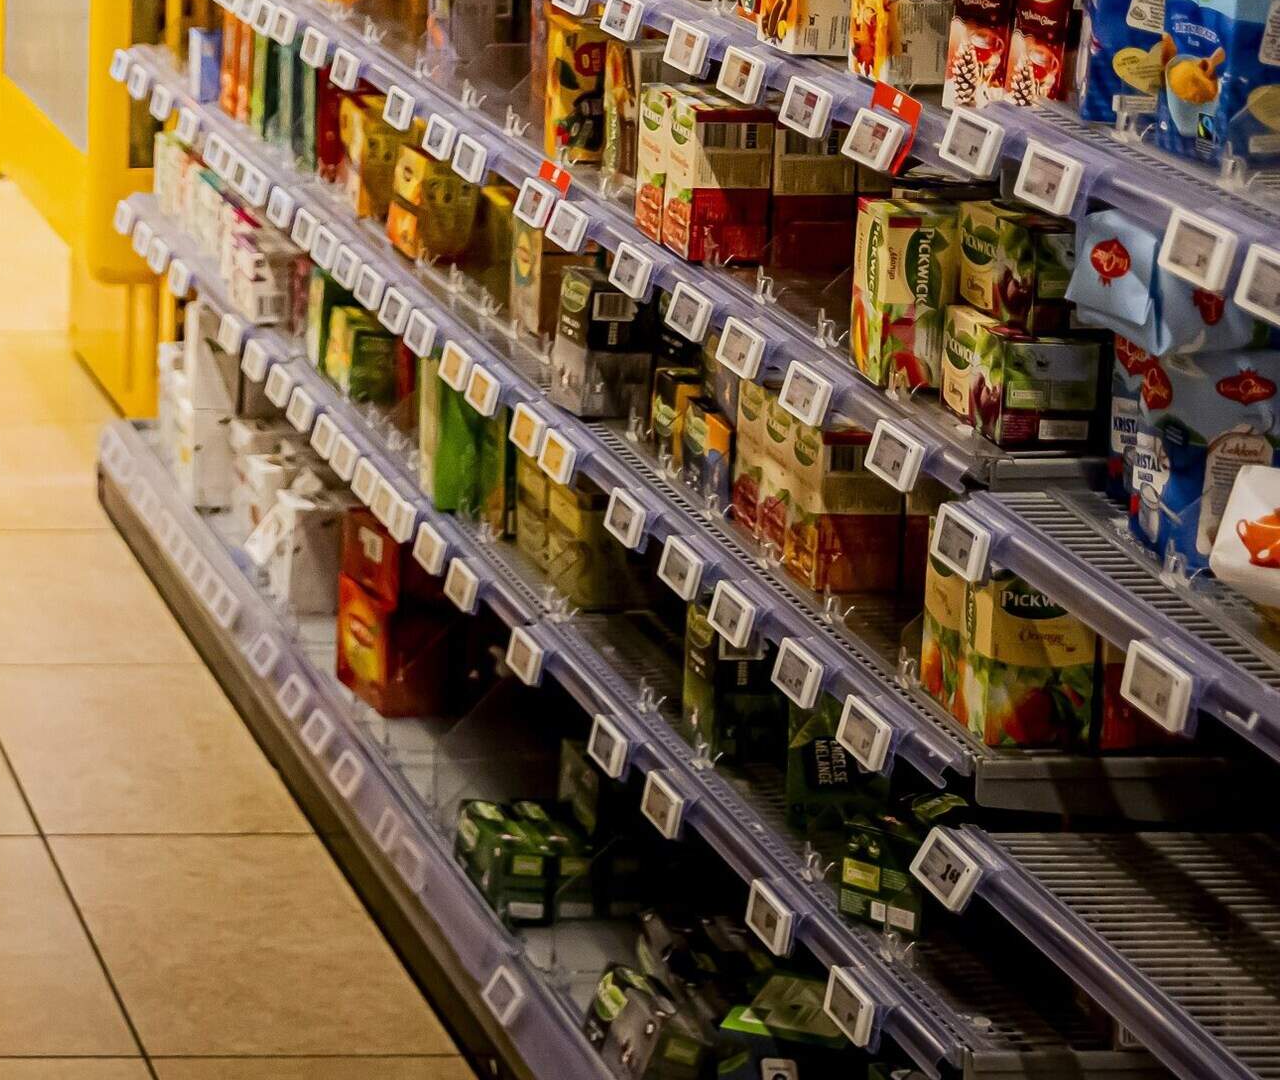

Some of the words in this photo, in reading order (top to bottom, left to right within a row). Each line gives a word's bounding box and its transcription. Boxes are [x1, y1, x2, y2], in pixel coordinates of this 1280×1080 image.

[868, 216, 882, 308] PICKWICK
[961, 227, 998, 259] PICKWICK
[915, 227, 935, 311] PICKWICK
[943, 330, 975, 363] PICKWICK
[1001, 590, 1061, 610] PICKW
[814, 739, 834, 786] MELANGE
